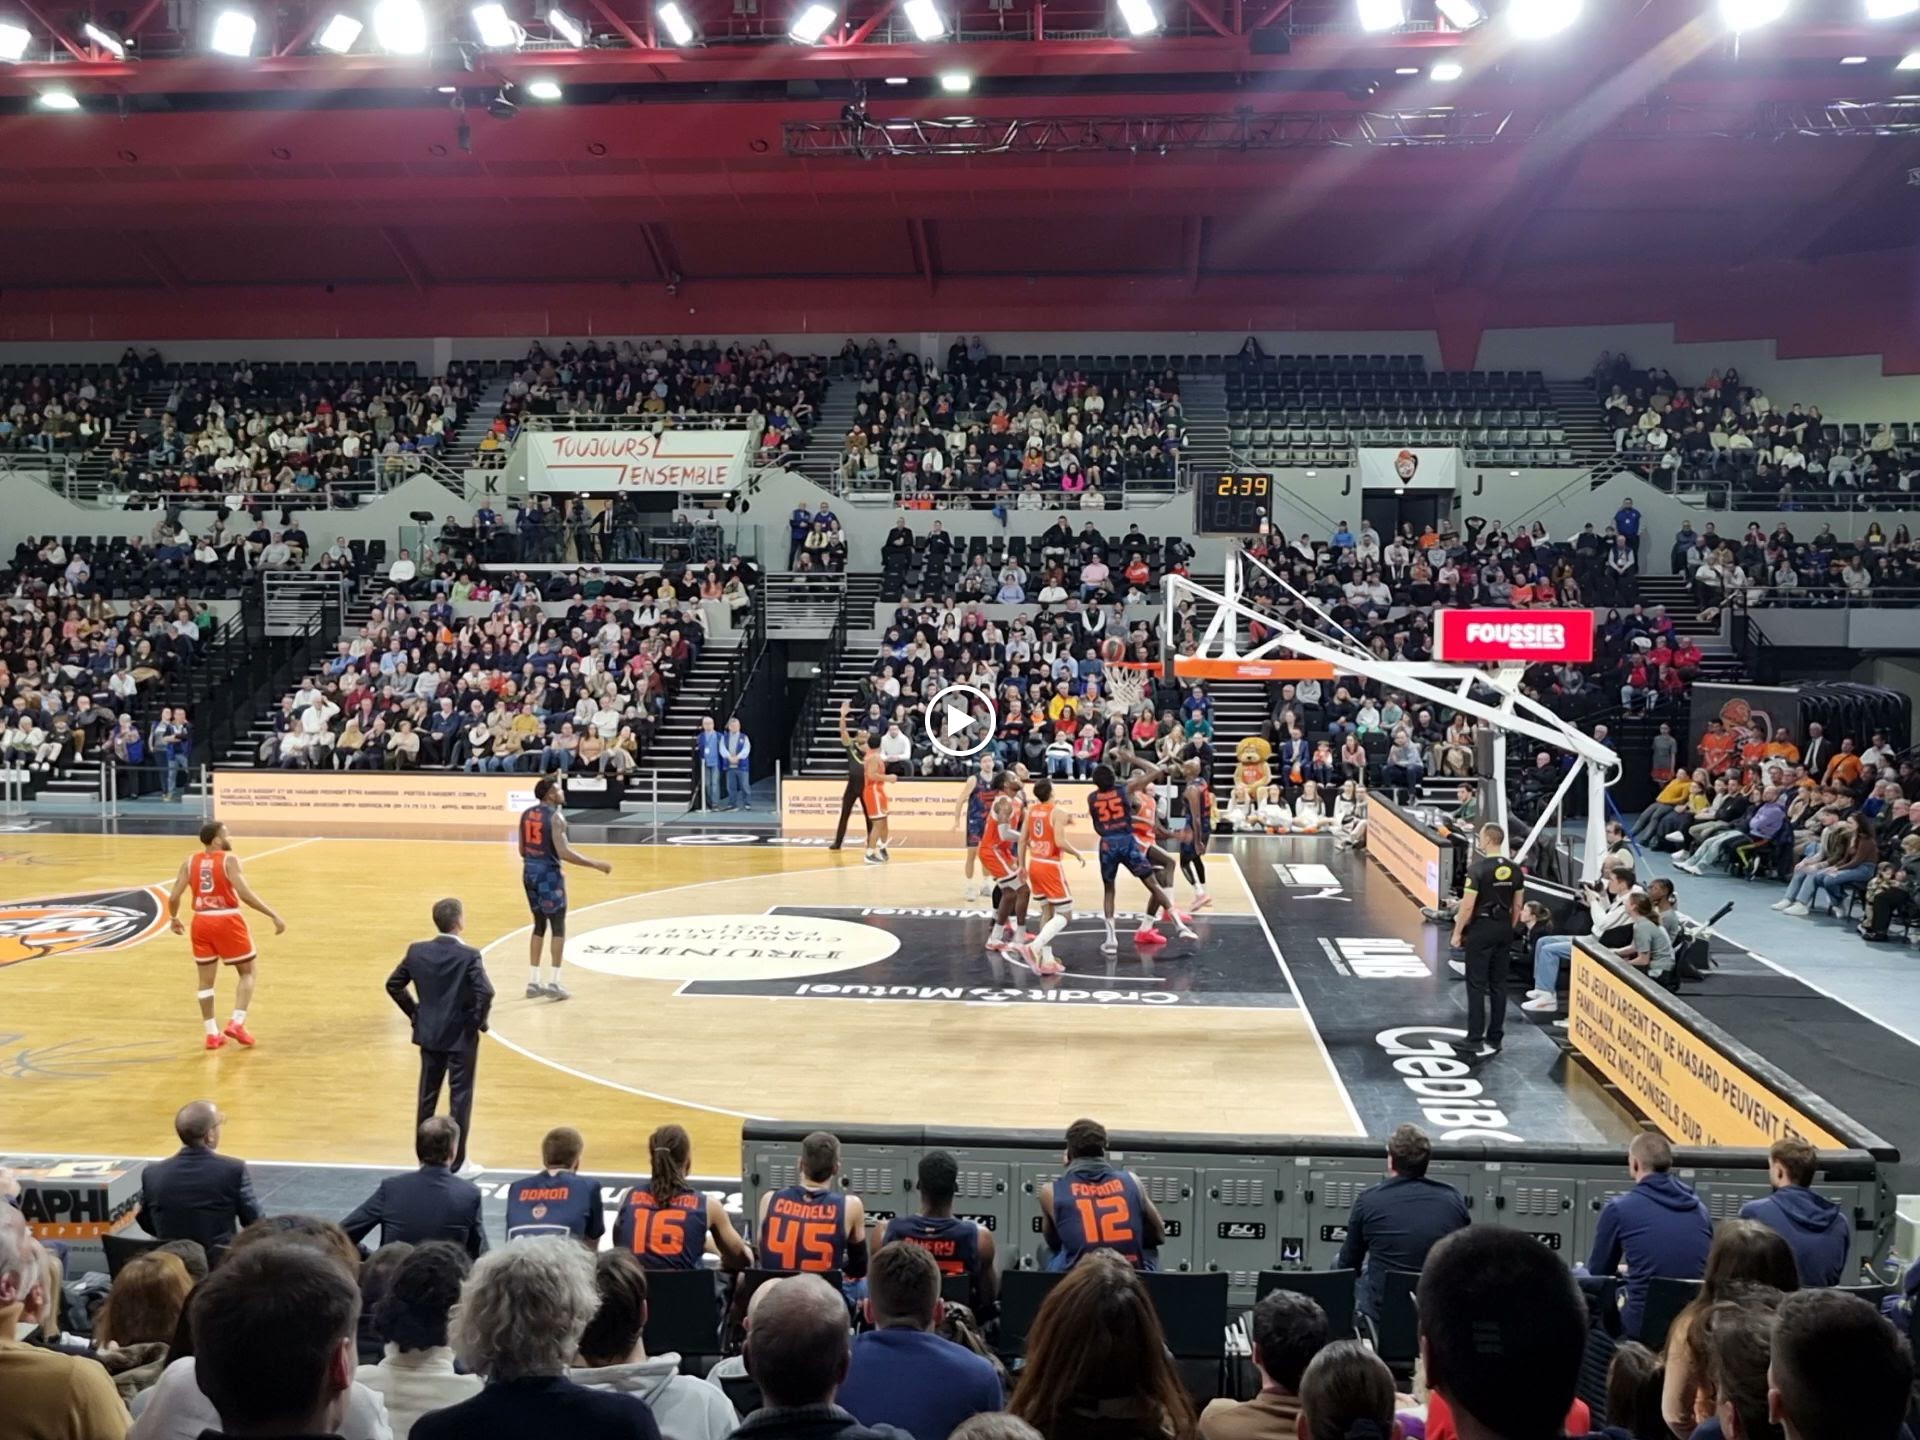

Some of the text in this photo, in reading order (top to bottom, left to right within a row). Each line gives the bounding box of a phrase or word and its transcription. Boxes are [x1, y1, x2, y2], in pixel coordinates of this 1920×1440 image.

[553, 436, 649, 460] TOUJOURS
[485, 475, 498, 493] K
[631, 466, 727, 485] ENSEMBLE
[1218, 476, 1268, 496] 2:39
[1467, 623, 1565, 643] FOUSSIER
[1094, 797, 1125, 822] 35
[525, 821, 543, 844] 13
[200, 868, 214, 893] 3
[795, 983, 1181, 1003] Crédit Mutuel
[1650, 1020, 1662, 1046] ET
[1664, 1031, 1675, 1059] DE
[1677, 1041, 1720, 1093] HASARD
[1722, 1077, 1779, 1140] PEUVENT
[1619, 1054, 1634, 1084] NOS
[1636, 1070, 1680, 1127] CONSEILS
[1682, 1112, 1702, 1145] SUR
[17, 1188, 109, 1223] APHI
[519, 1187, 569, 1201] DOMON
[775, 1199, 837, 1220] CORNELY
[1075, 1195, 1133, 1243] 12
[633, 1208, 687, 1255] 16
[768, 1216, 836, 1271] 45
